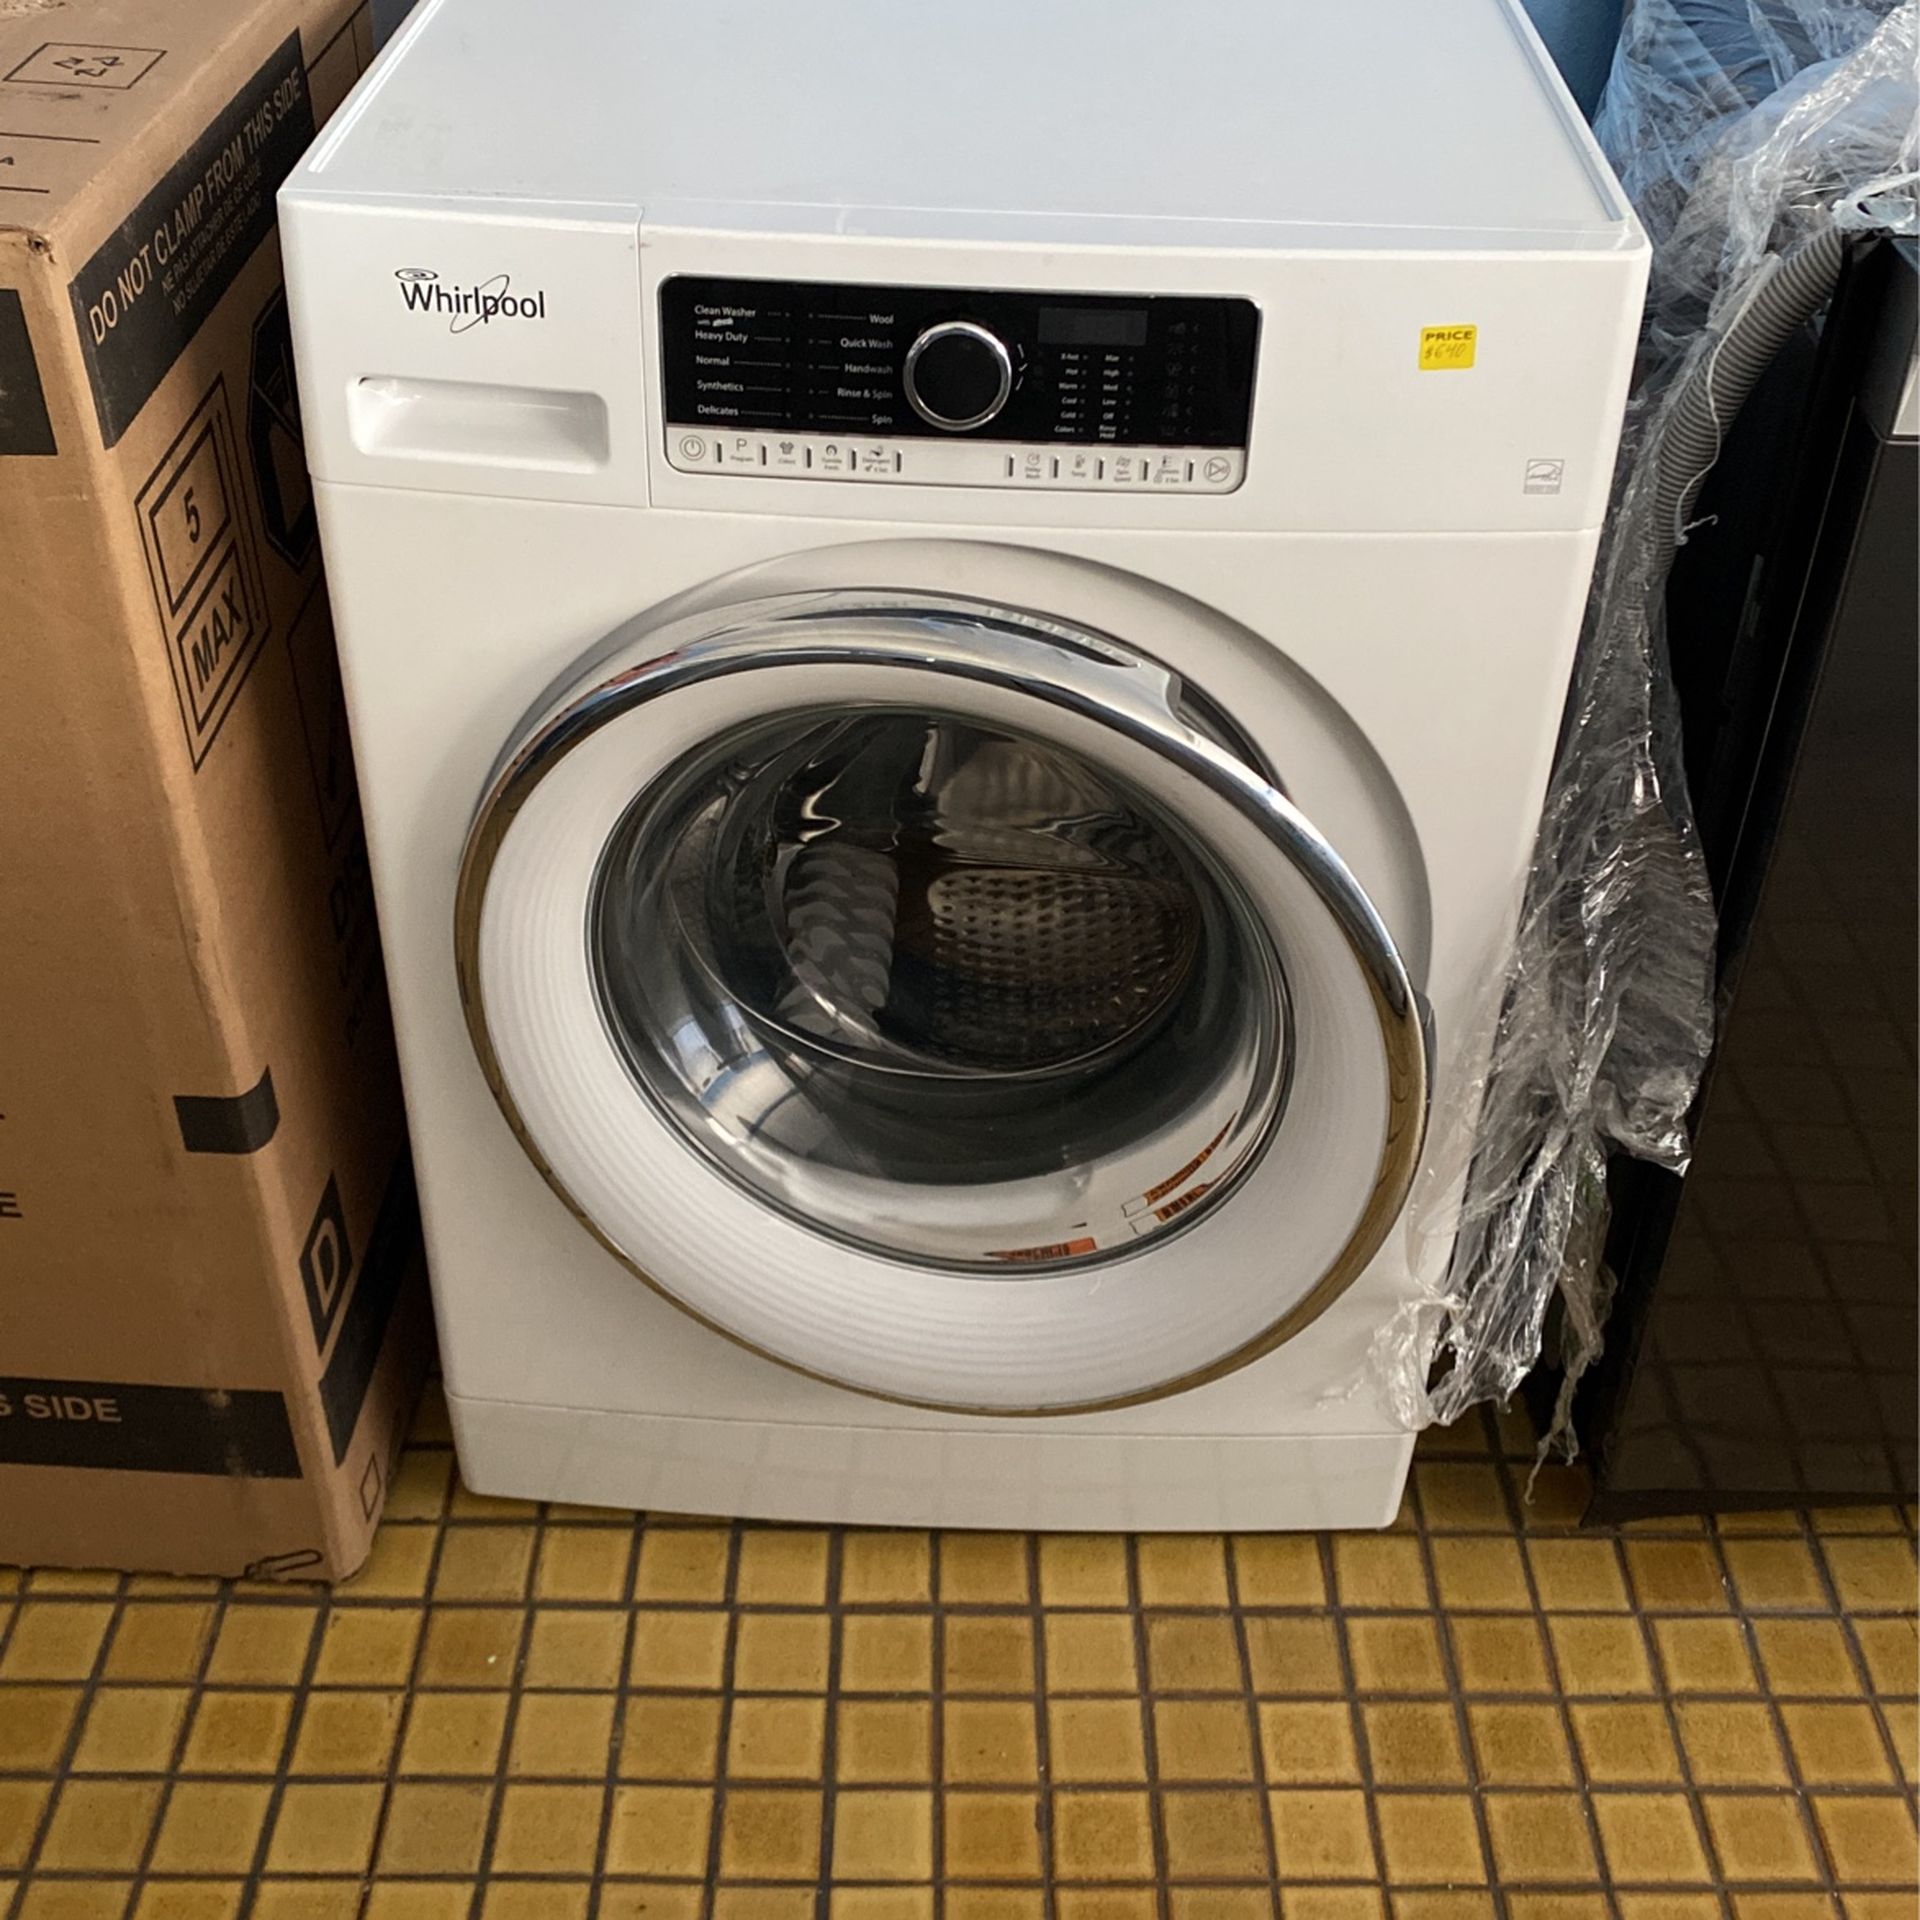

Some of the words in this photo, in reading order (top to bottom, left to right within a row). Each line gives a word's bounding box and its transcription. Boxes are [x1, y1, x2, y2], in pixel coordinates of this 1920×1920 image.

[89, 290, 118, 345] DO
[117, 244, 153, 311] NOT
[154, 183, 204, 265] CLAMP
[204, 135, 245, 201] FROM
[243, 101, 274, 154] THIS
[272, 67, 301, 121] SIDE
[400, 281, 545, 324] Whirlpool
[694, 304, 720, 316] Clean
[721, 306, 756, 318] Washer
[869, 314, 894, 325] Wool
[695, 330, 723, 342] Heavy
[725, 332, 748, 344] Duty
[1425, 330, 1473, 341] PRICE
[840, 337, 867, 349] Quick
[868, 338, 893, 349] Wash
[695, 355, 730, 367] Normal
[844, 363, 893, 374] Handwash
[696, 379, 745, 392] Synthetics
[837, 387, 862, 398] Rinse
[863, 389, 871, 398] &
[872, 388, 893, 401] Spin
[697, 404, 739, 417] Delicates
[871, 413, 893, 426] Spin
[736, 438, 748, 451] P
[184, 486, 201, 544] 5
[191, 577, 242, 693] MAX
[23, 1393, 123, 1423] SIDE
